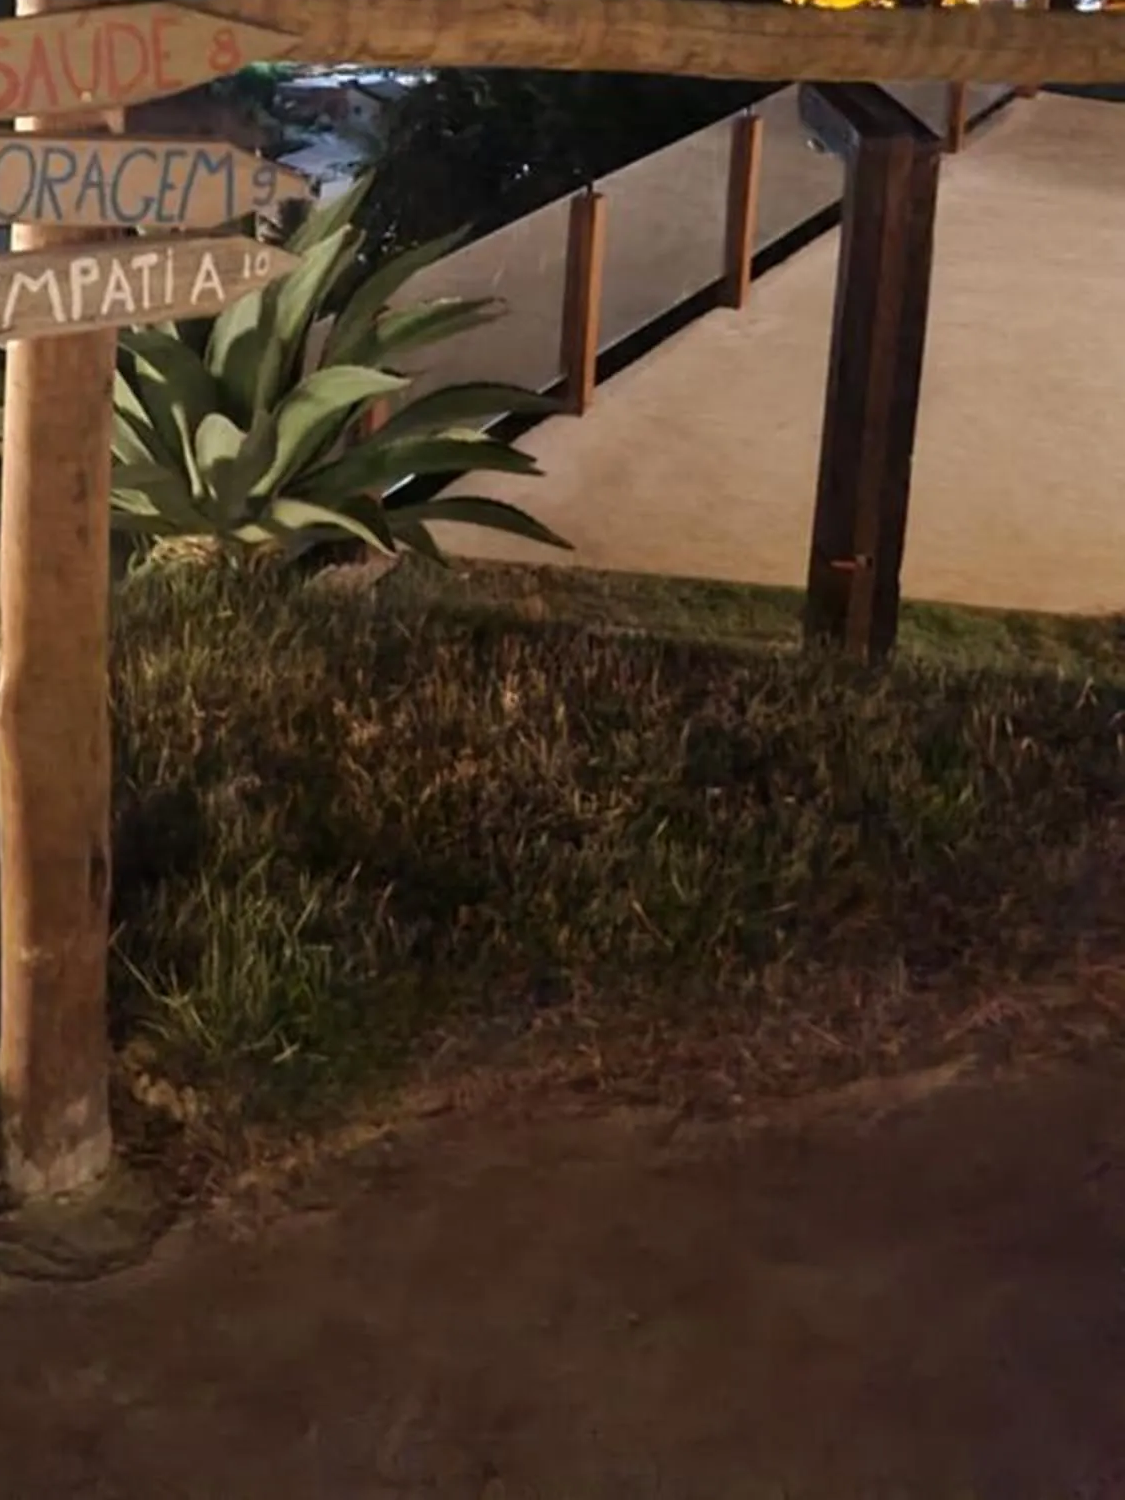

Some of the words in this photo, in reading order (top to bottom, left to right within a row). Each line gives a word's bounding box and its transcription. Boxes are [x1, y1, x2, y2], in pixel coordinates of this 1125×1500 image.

[207, 27, 243, 72] 8
[251, 166, 280, 208] 9
[242, 251, 272, 280] 10
